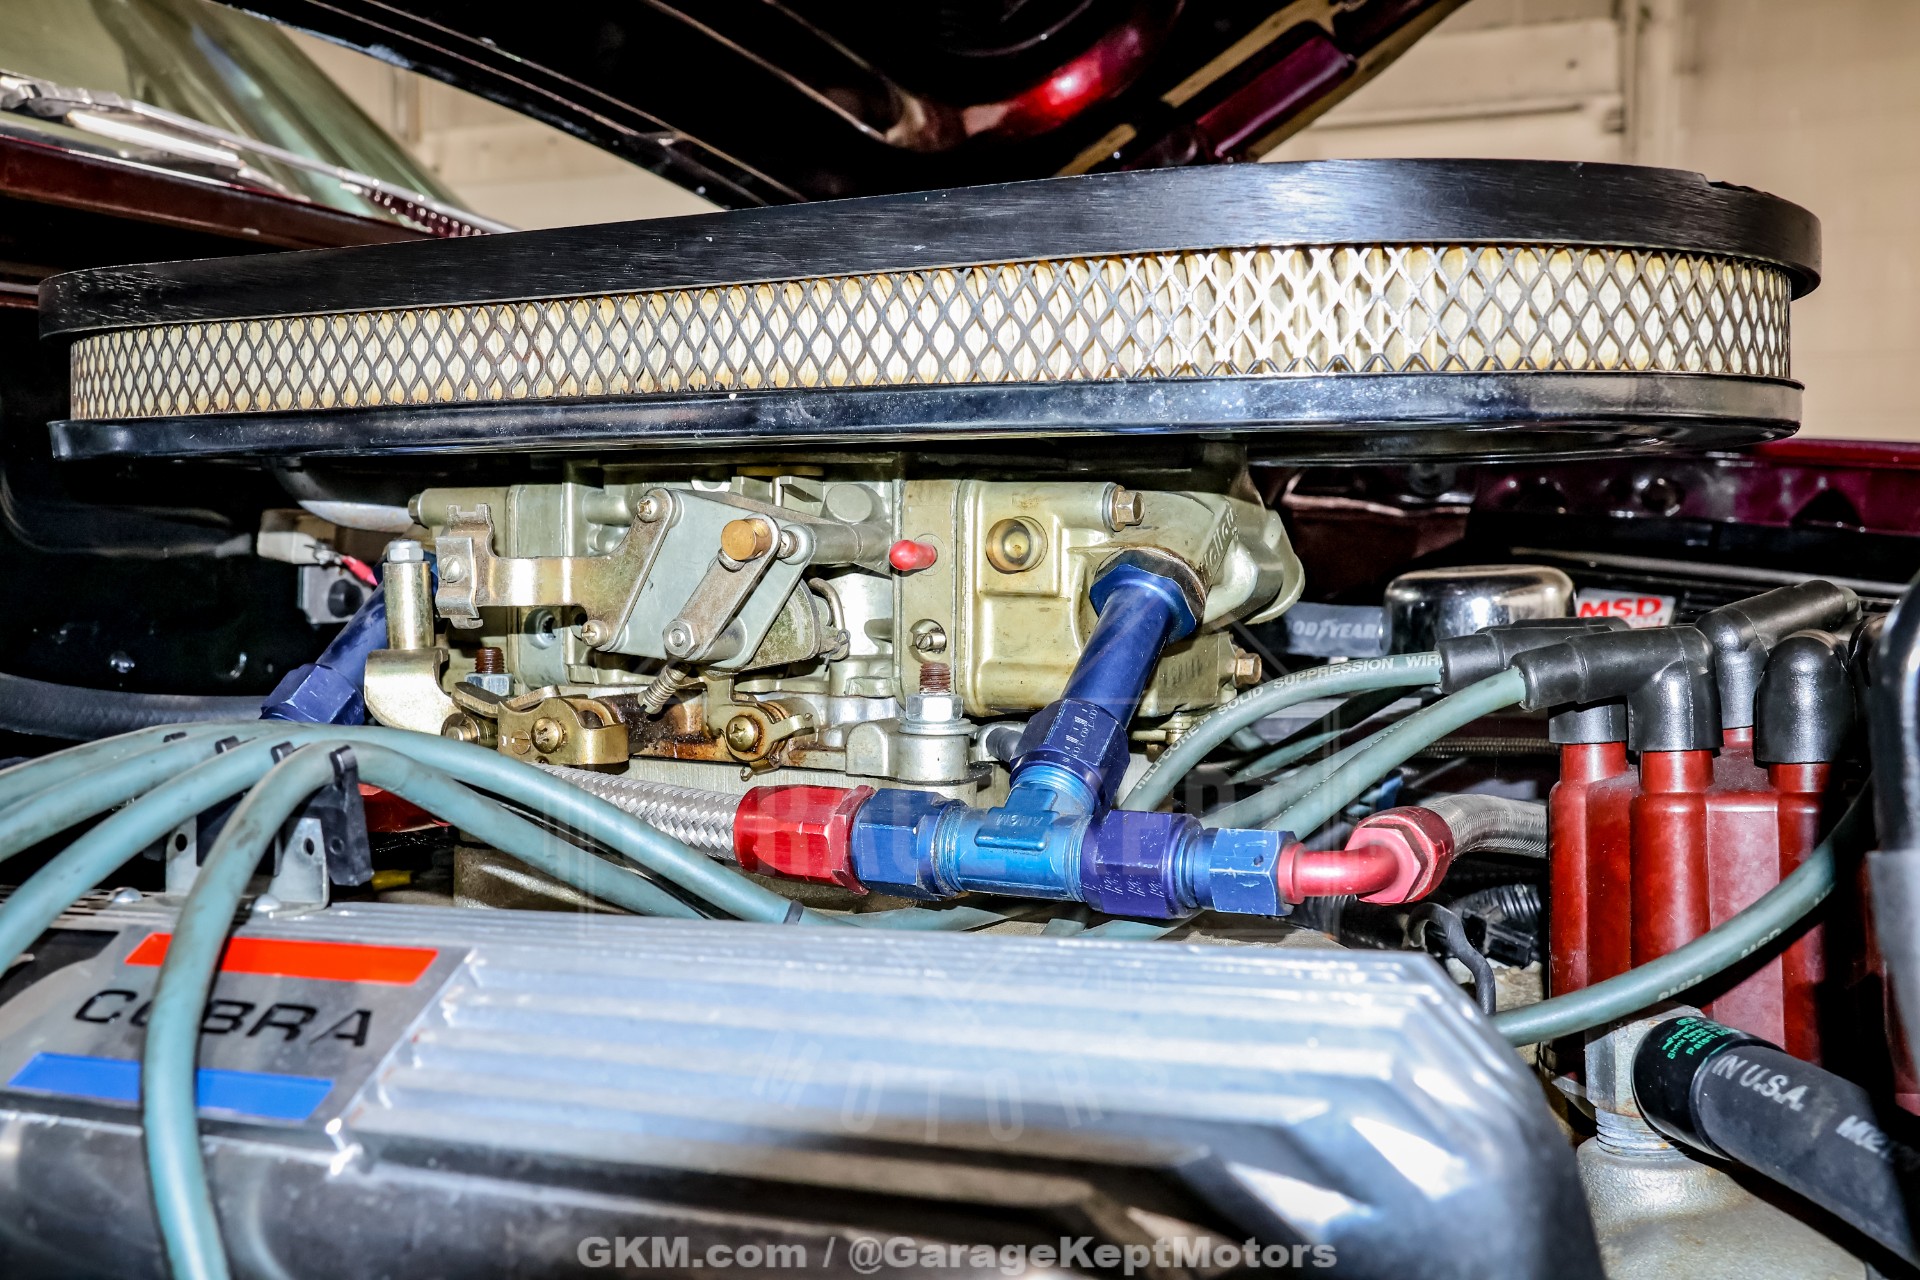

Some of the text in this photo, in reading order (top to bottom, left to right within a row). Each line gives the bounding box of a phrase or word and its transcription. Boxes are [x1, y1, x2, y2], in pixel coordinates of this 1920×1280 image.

[1579, 596, 1663, 618] MSD
[1292, 619, 1379, 641] ODYEAR
[1218, 686, 1264, 715] SOLID
[1273, 657, 1394, 689] SUPPRESSION
[1406, 655, 1441, 668] WIR
[1712, 1054, 1748, 1080] IN
